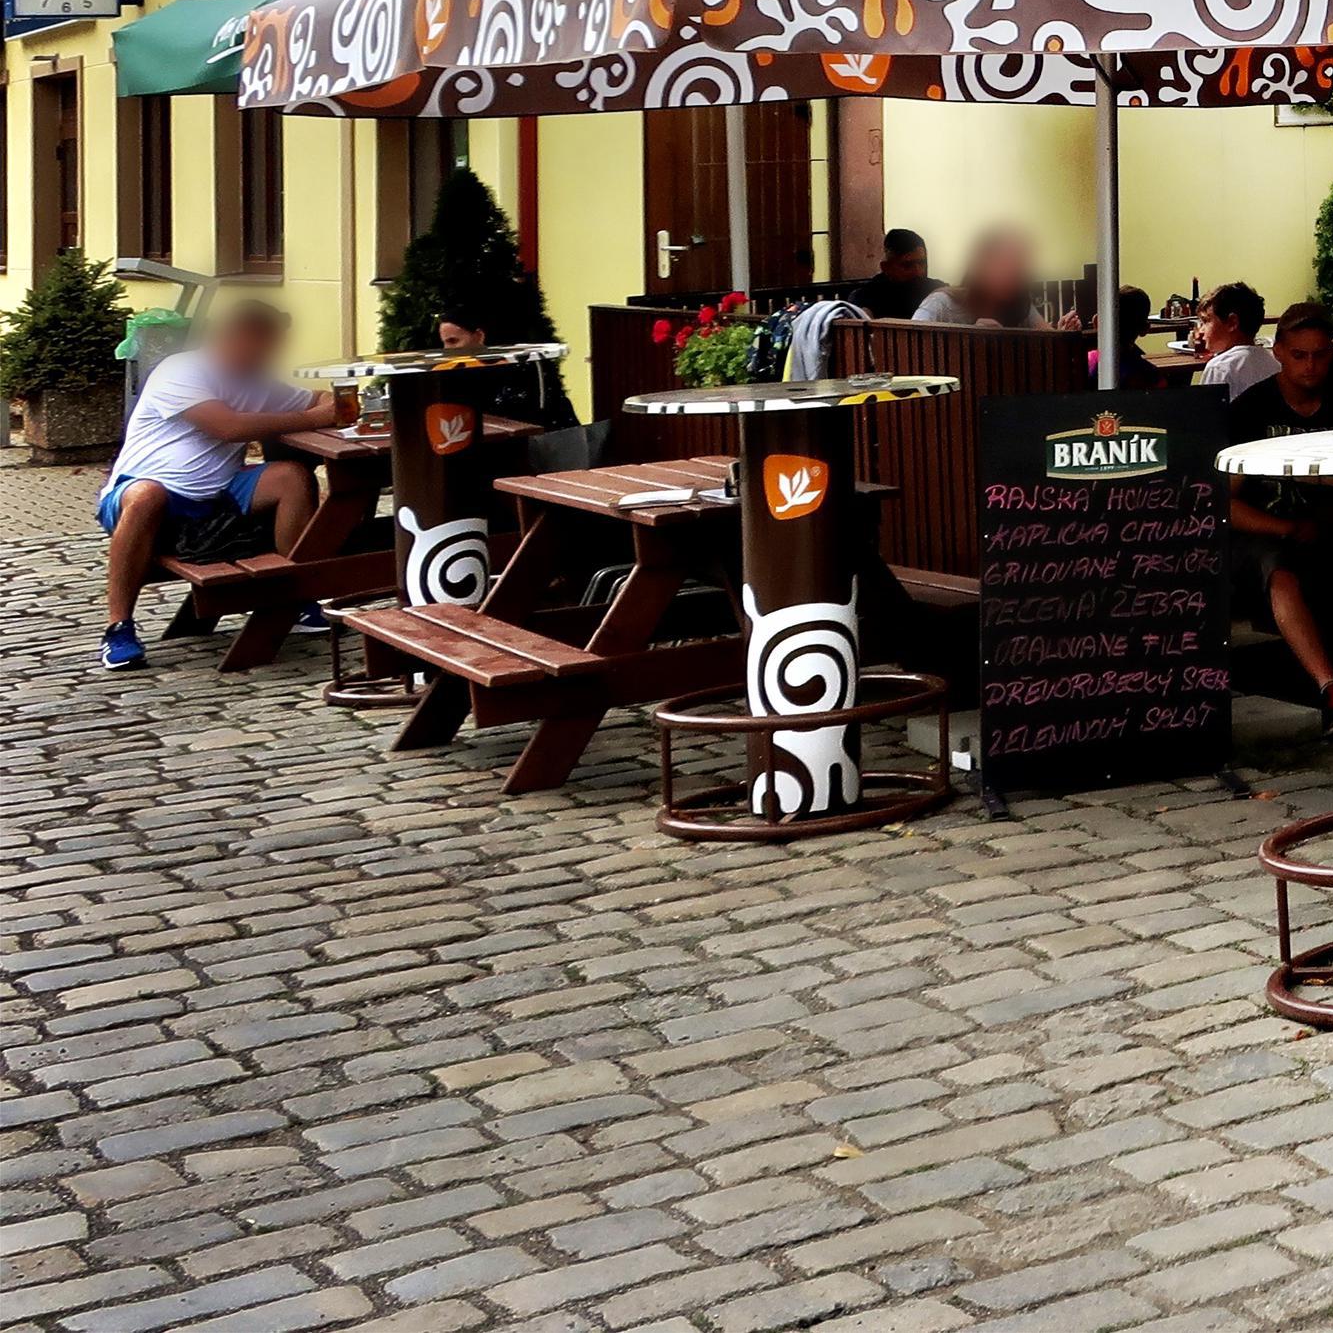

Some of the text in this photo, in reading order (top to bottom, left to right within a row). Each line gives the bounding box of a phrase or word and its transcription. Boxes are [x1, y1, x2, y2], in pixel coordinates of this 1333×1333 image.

[62, 2, 71, 13] 6
[1053, 434, 1158, 468] BRANÍK
[984, 481, 1098, 512] RAJSKÁ
[1190, 483, 1212, 511] P.
